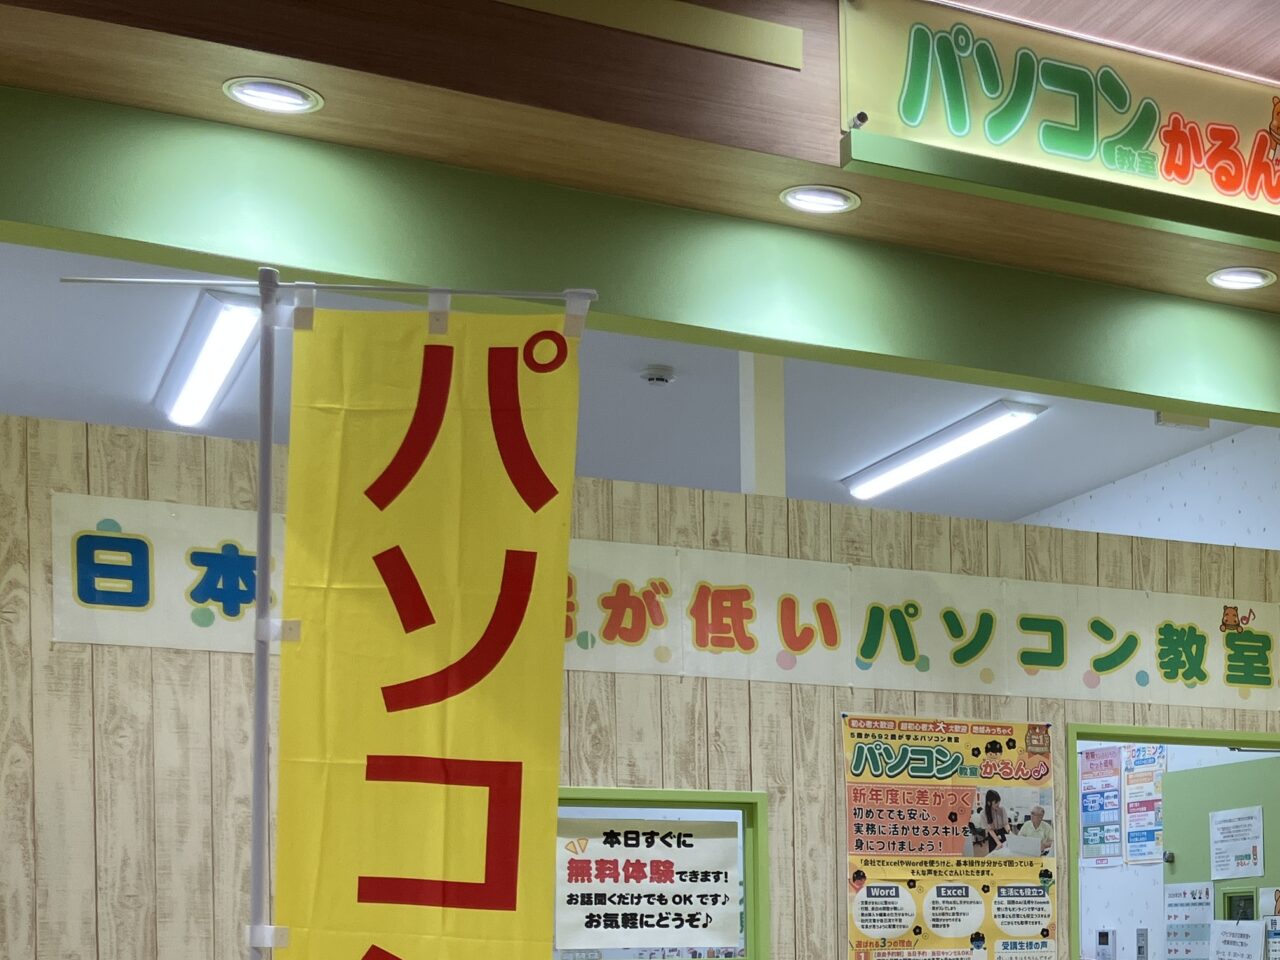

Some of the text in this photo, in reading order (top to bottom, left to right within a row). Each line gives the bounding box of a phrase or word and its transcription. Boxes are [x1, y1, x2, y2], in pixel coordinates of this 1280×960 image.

[899, 23, 1160, 170] パソコン
[1115, 144, 1159, 178] 教室
[71, 530, 278, 623] 日本
[567, 573, 1278, 691] が低いパソコン教室
[851, 741, 964, 779] パソコン
[980, 759, 1031, 779] かるん
[852, 788, 982, 807] 新年度に差がつく!
[853, 808, 938, 821] 初めてでも安心。
[602, 829, 694, 848] 本日すぐに
[853, 823, 971, 837] 実務に活かせるスキルを
[855, 837, 943, 852] 身につけましょう!
[567, 858, 729, 884] 無料体験 できます!
[566, 893, 668, 906] お話聞くだけでも
[672, 893, 693, 906] OK
[870, 887, 896, 897] Word
[940, 887, 966, 897] Excel
[1000, 886, 1044, 897] 生活にも役立つ
